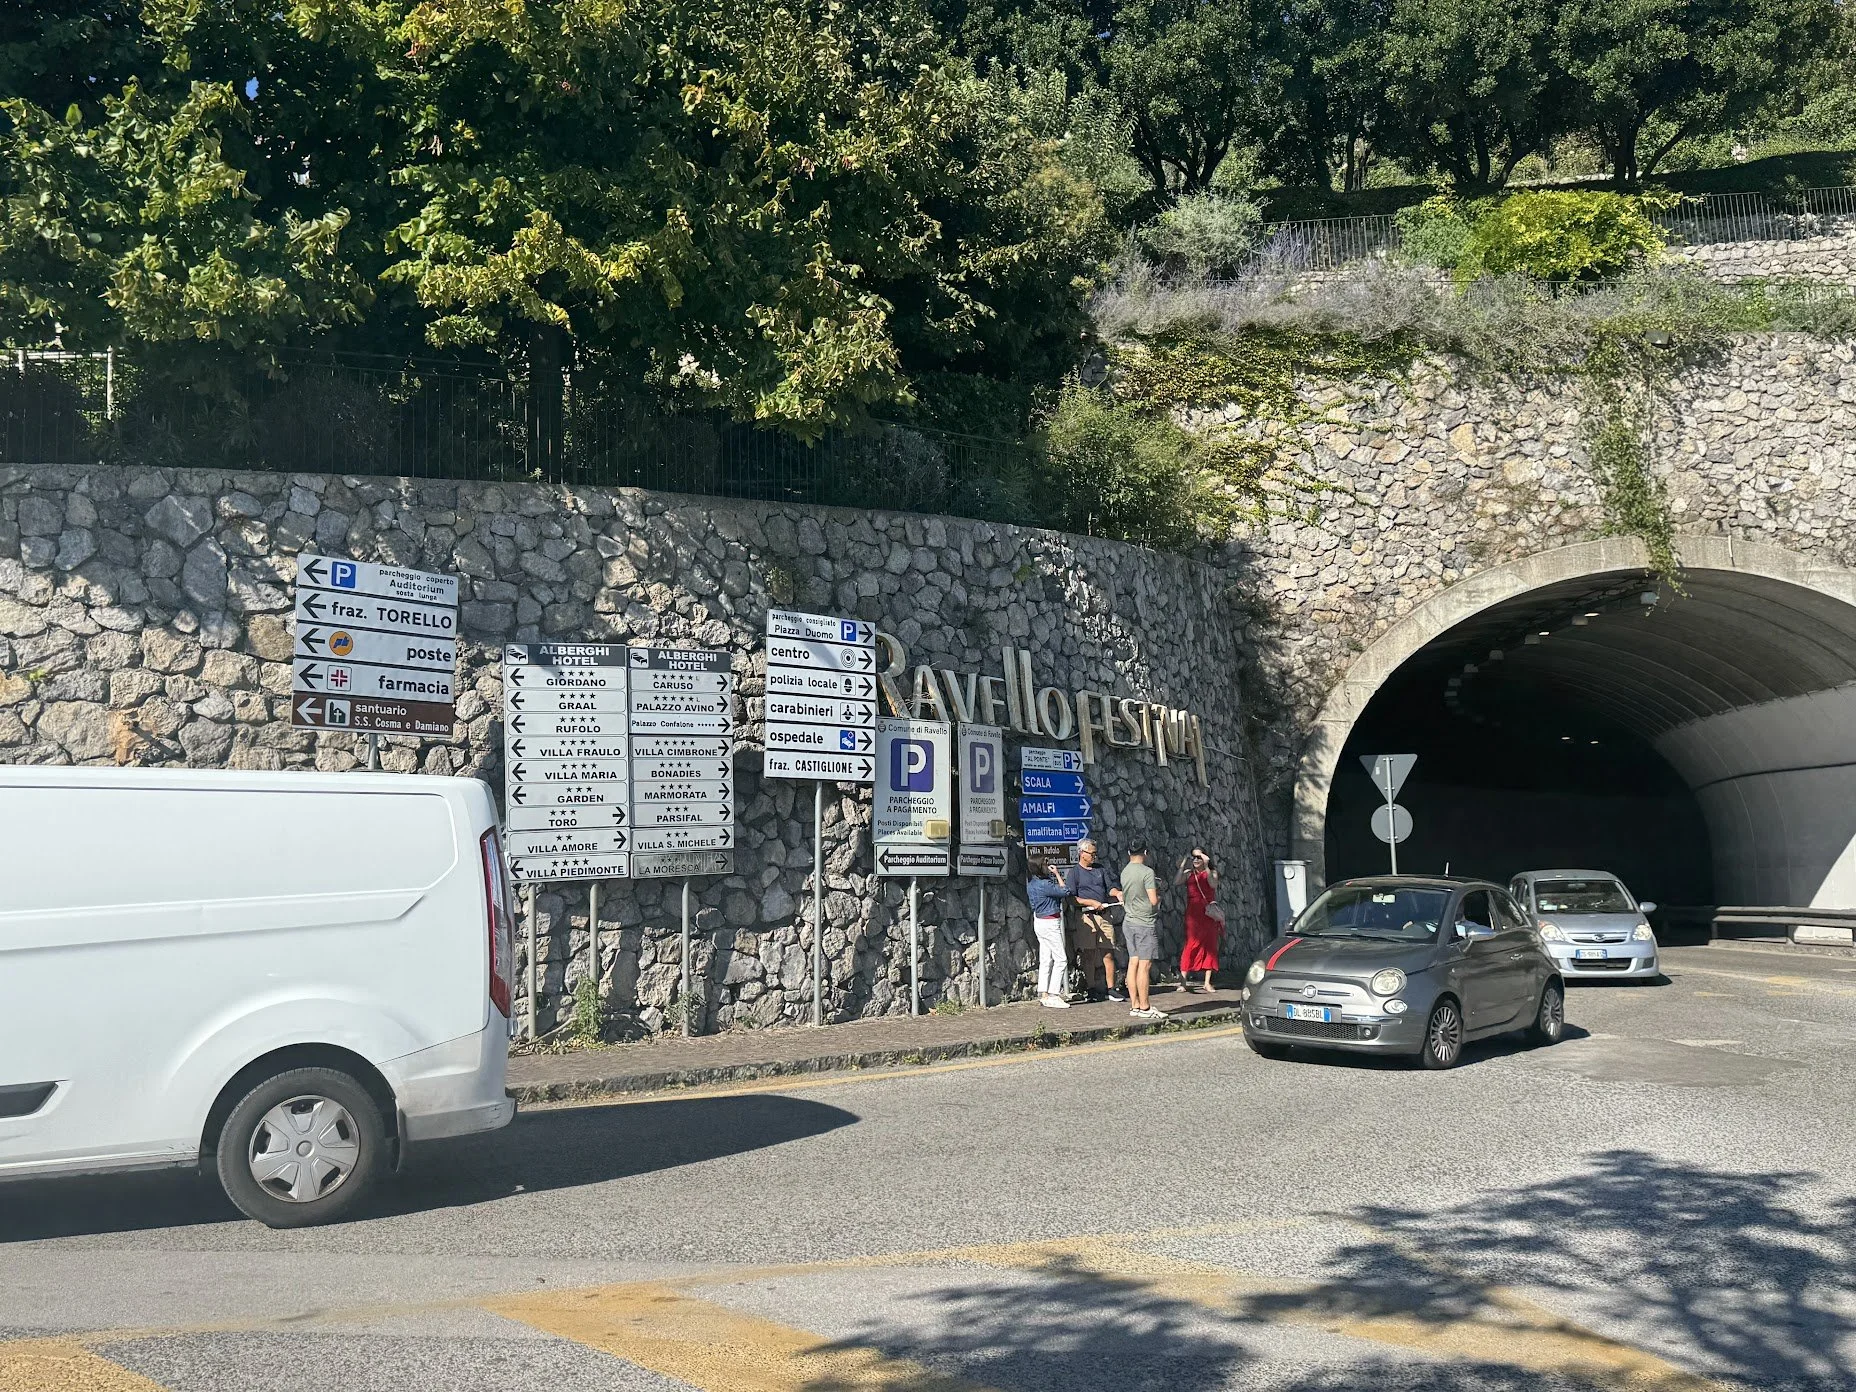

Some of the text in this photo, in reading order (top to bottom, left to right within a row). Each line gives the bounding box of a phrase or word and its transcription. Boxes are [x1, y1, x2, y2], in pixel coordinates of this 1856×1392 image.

[335, 564, 351, 585] P
[379, 568, 454, 586] parcheggio coperto
[389, 579, 444, 595] Auditorium
[396, 590, 437, 601] sosta lunga
[331, 602, 452, 629] fraz. TORELLO
[806, 617, 836, 627] consigliato
[774, 625, 834, 640] Piazza Duomo
[843, 623, 854, 639] P
[406, 647, 451, 662] poste
[539, 646, 610, 656] ALBERGHI
[658, 651, 717, 662] ALBERGHI
[771, 646, 810, 660] centro
[552, 656, 598, 666] HOTEL
[668, 660, 707, 671] HOTEL
[378, 675, 449, 695] farmacia
[546, 678, 607, 687] GIORDANO
[653, 681, 693, 690] CARUSO
[770, 674, 838, 689] polizia locale
[355, 704, 407, 716] santuario
[558, 702, 597, 710] GRAAL
[636, 703, 714, 712] PALAZZO AVINO
[770, 703, 833, 718] carabinieri
[354, 716, 449, 732] S.S. Cosma e Damiano
[555, 725, 601, 733] RUFOLO
[631, 720, 694, 728] Palazzo Confalone
[888, 724, 915, 733] Comune
[924, 727, 948, 735] Ravello
[770, 731, 824, 745] ospedale
[540, 748, 621, 757] VILLA FRAULO
[635, 748, 717, 756] VILLA CIMBRONE
[769, 758, 853, 774] fraz. CASTIGLIONE
[900, 743, 927, 787] P
[976, 747, 990, 787] P
[544, 771, 618, 780] VILLA MARIA
[651, 770, 702, 778] BONADIES
[1024, 777, 1051, 788] SCALA
[557, 795, 604, 803] GARDEN
[644, 791, 707, 799] MARMORATA
[889, 796, 935, 805] PARCHEGGIO
[893, 806, 937, 814] PAGAMENTO
[1022, 802, 1056, 813] AMALFI
[656, 814, 703, 823] PARSIFAL
[1027, 827, 1062, 836] amalfitana
[527, 843, 598, 853] VILLA AMORE
[637, 838, 716, 850] VILLA S. MICHELE
[884, 855, 946, 865] Parcheggio Auditorium
[526, 865, 624, 878] VILLA PIEDIMONTE
[639, 864, 700, 874] LA MORESCA
